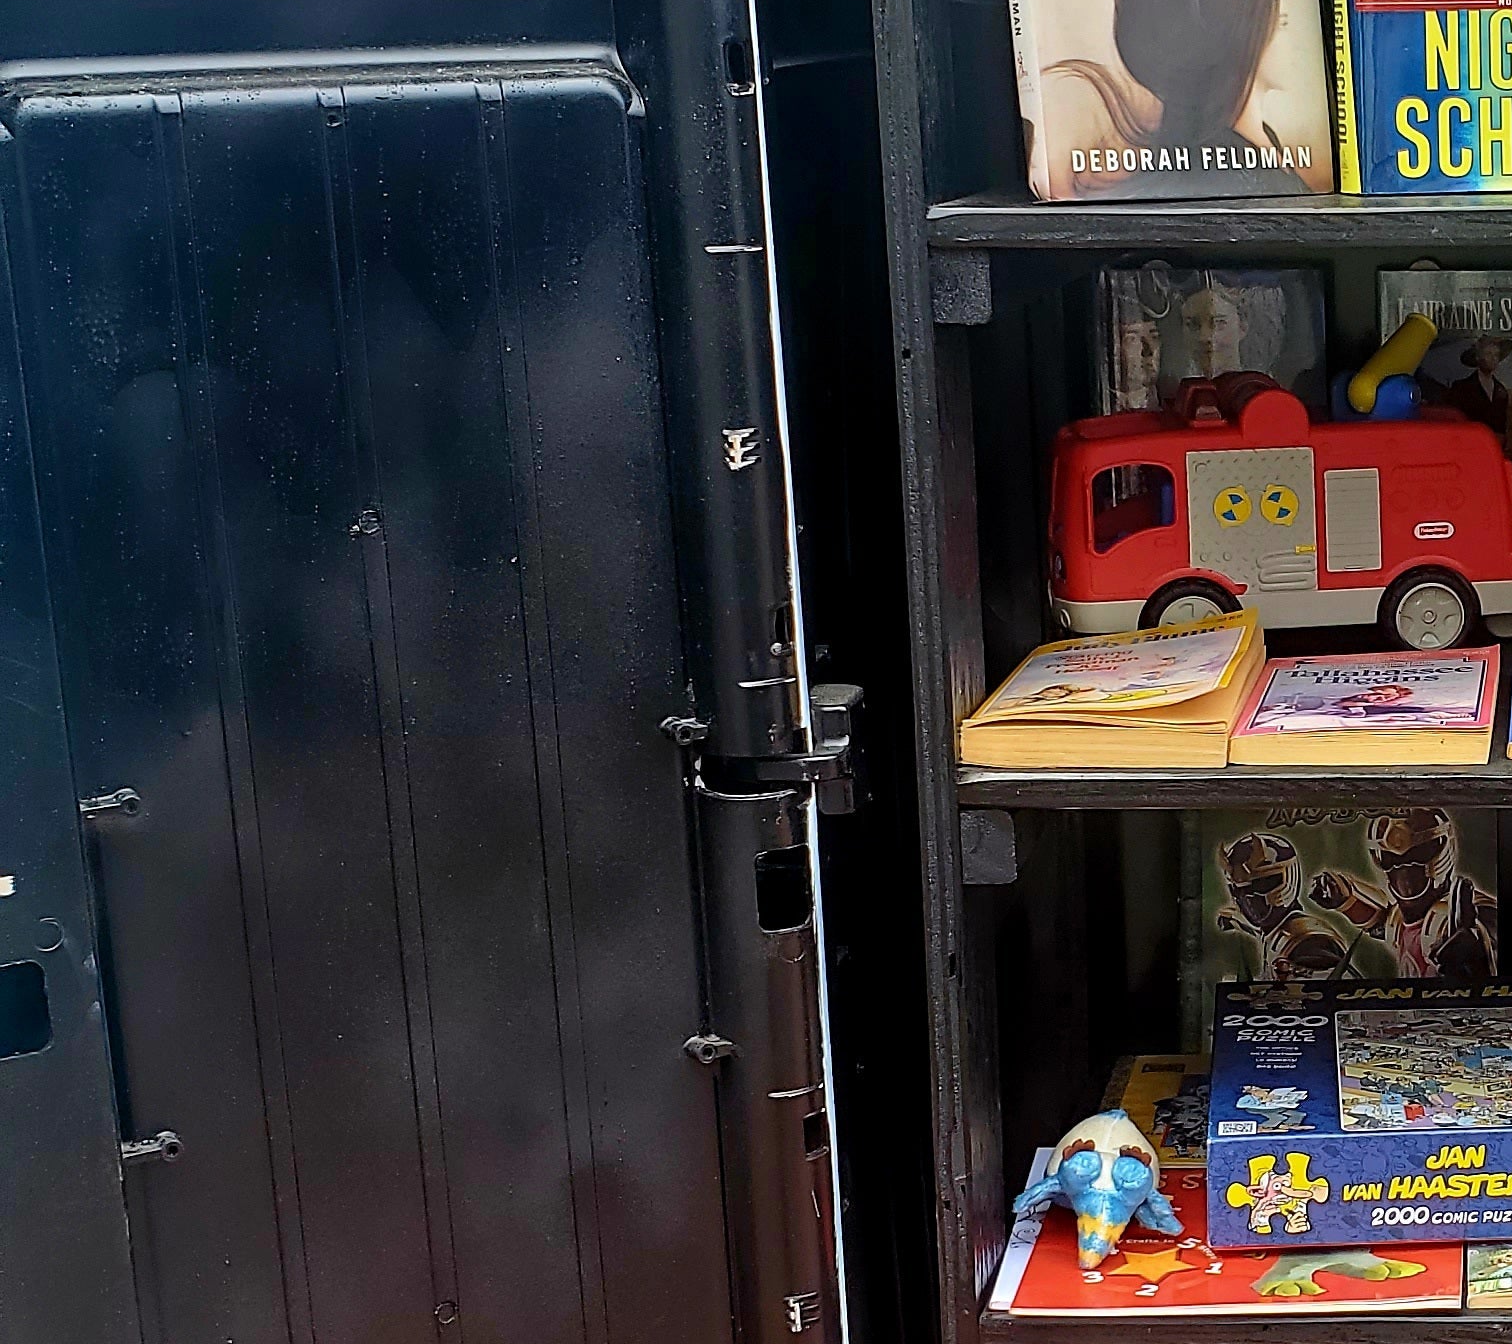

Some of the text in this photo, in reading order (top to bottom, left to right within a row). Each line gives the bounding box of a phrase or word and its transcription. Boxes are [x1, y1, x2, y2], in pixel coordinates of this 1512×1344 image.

[1336, 61, 1348, 145] SCHOOL
[1072, 146, 1312, 173] DEBORAH FELDMAN
[1285, 665, 1474, 678] Tallahassee
[1314, 674, 1440, 685] Higgins
[1336, 987, 1414, 1000] JAN
[1421, 989, 1472, 999] VAN
[1222, 1015, 1329, 1027] 2000
[1426, 1144, 1486, 1170] JAN
[1342, 1183, 1383, 1202] VAN
[1371, 1206, 1430, 1227] 2000
[1431, 1211, 1479, 1225] COMIC
[1177, 1238, 1202, 1249] 5
[1204, 1261, 1224, 1275] 1
[1081, 1270, 1105, 1284] 3
[1135, 1284, 1159, 1297] 2
